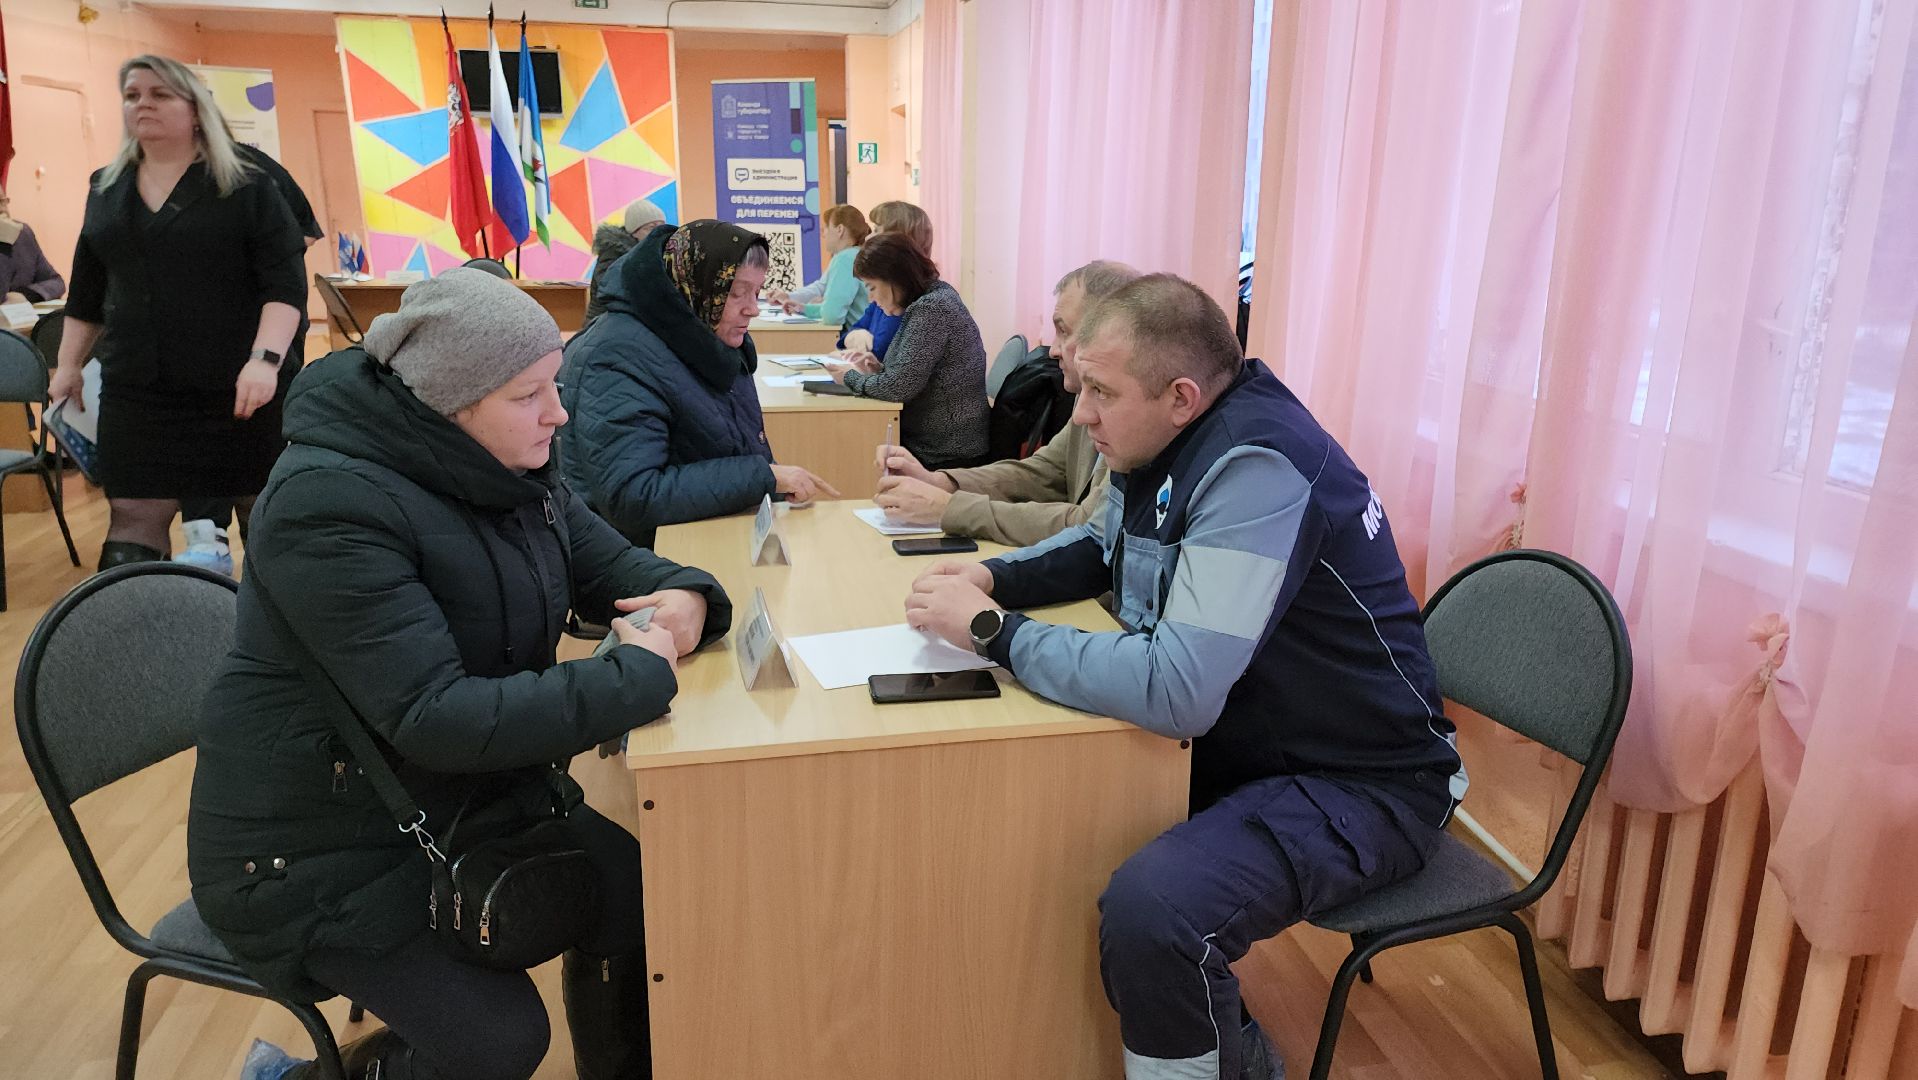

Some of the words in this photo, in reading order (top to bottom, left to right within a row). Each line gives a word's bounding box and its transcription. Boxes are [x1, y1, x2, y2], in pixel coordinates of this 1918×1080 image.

[730, 195, 804, 206] ОБЪЕДИНЯЕМСЯ
[736, 208, 757, 219] ДЛЯ
[757, 209, 799, 219] ПЕРЕМЕН
[1361, 485, 1383, 541] МО
